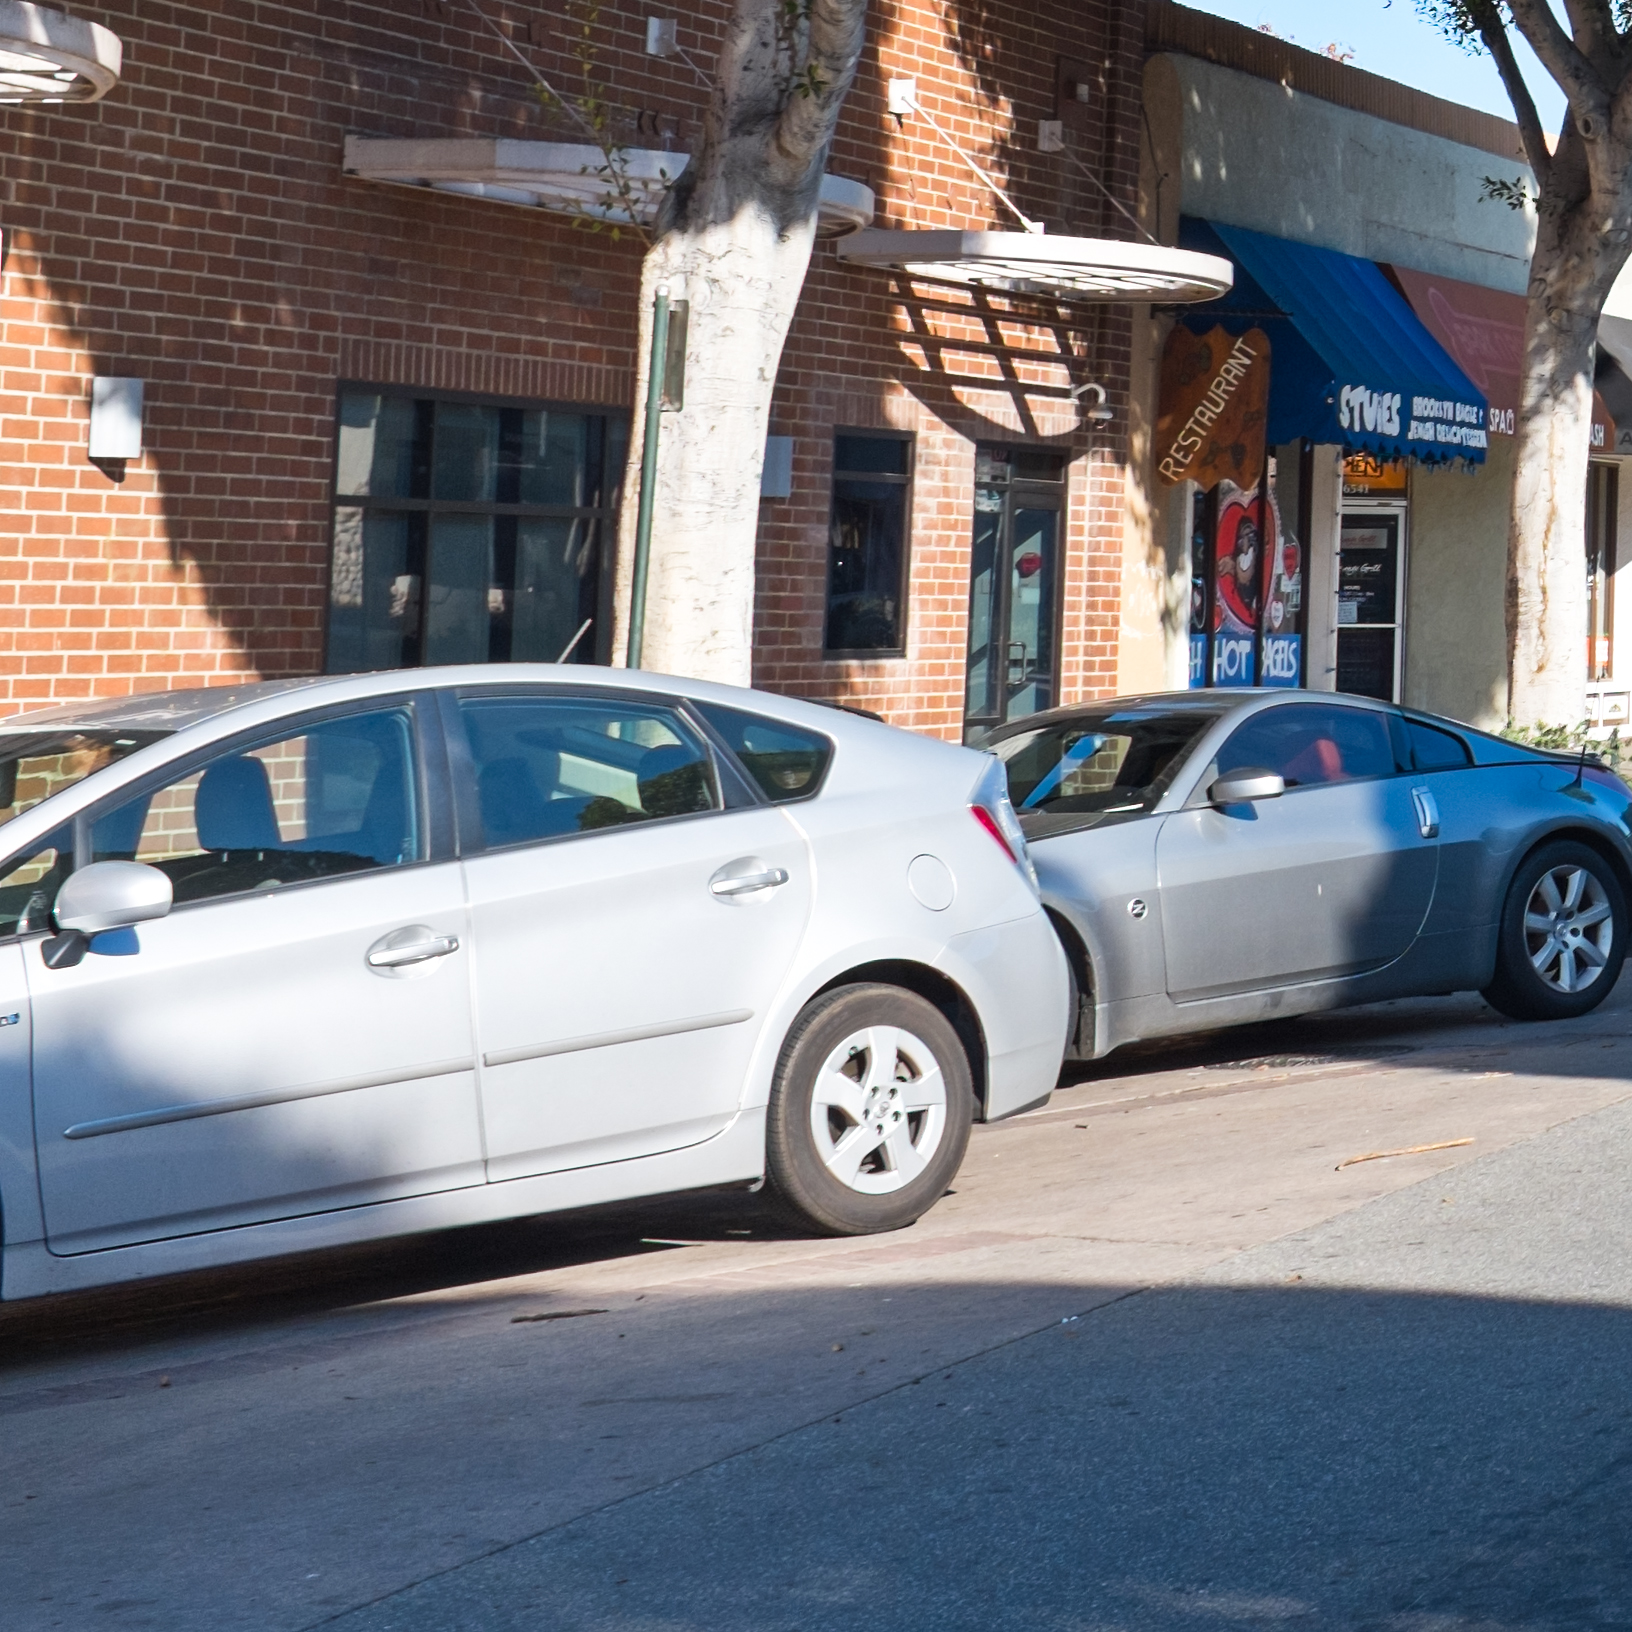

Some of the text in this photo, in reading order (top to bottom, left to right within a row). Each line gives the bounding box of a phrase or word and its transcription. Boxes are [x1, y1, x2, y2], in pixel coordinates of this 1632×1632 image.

[1158, 337, 1258, 481] RESTAURANT
[1412, 396, 1454, 421] BROOKLYN
[1591, 423, 1605, 447] ASH
[1343, 483, 1369, 494] 6541
[1212, 638, 1252, 684] HOT
